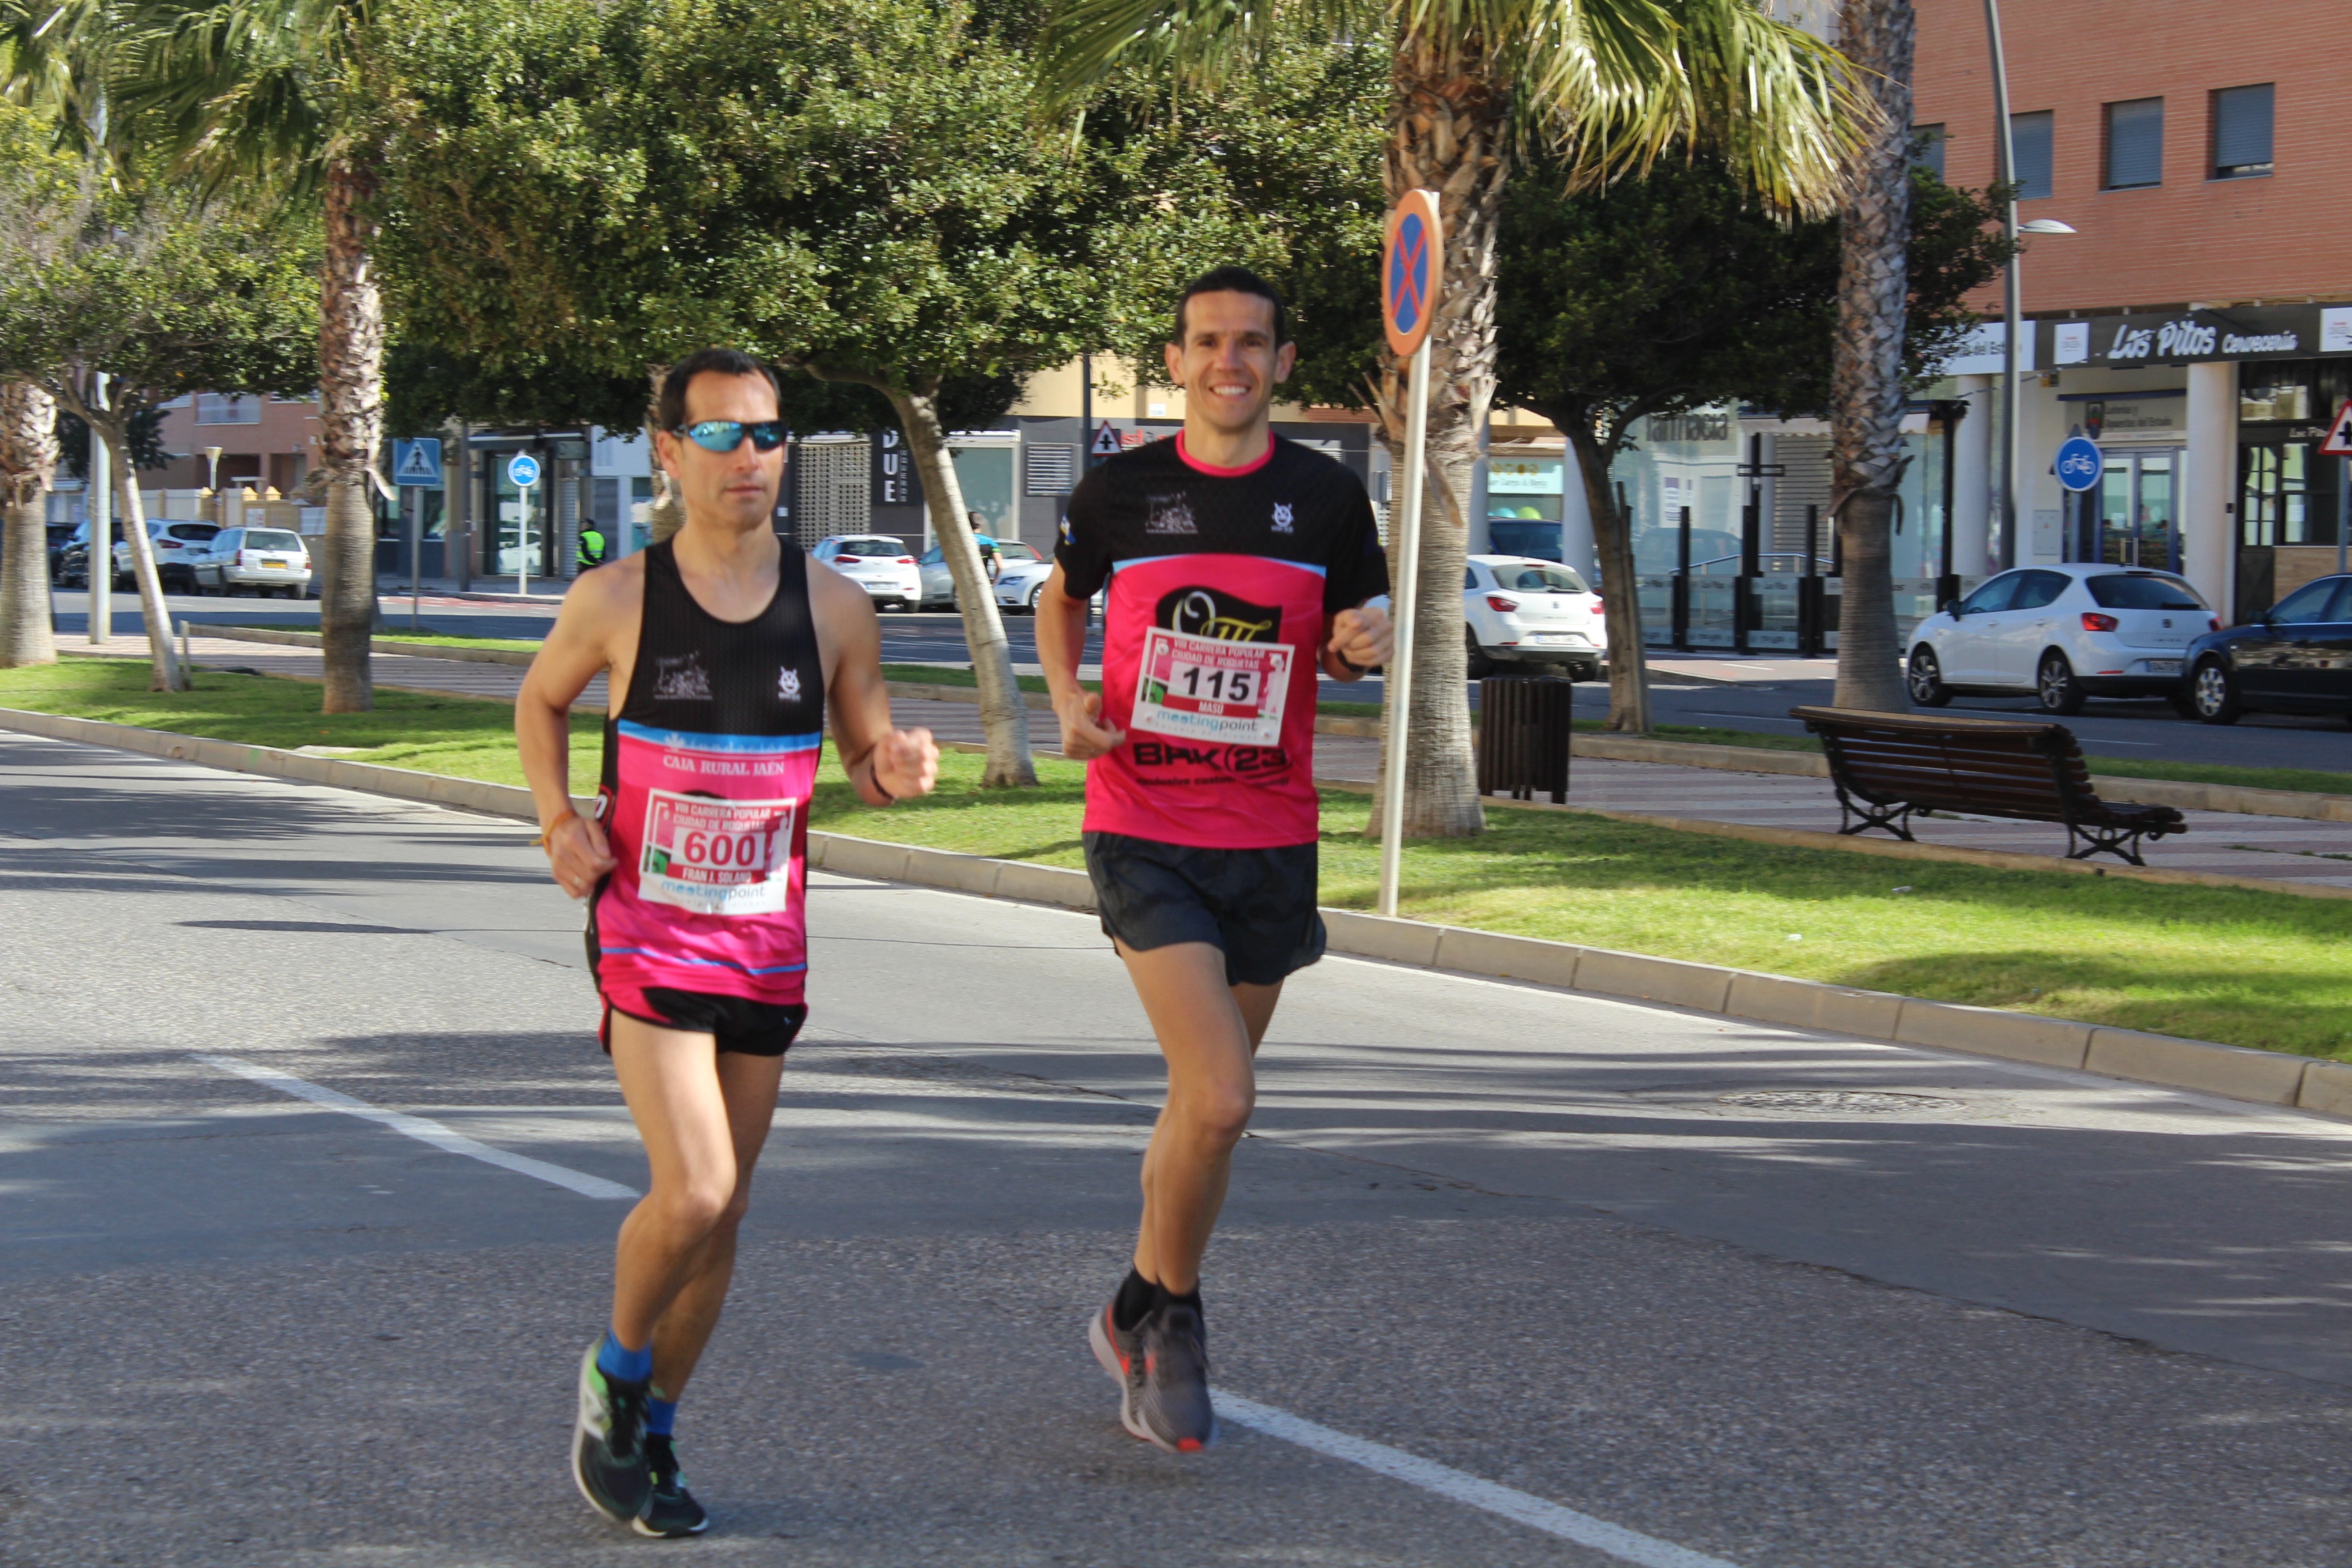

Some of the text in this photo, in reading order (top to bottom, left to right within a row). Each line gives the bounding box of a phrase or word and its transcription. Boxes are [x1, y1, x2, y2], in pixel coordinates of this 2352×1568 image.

[2108, 324, 2152, 359] Los
[2157, 320, 2217, 357] Pitos
[1188, 640, 1226, 655] CARRERA
[1228, 647, 1266, 659] POPULAR
[1171, 649, 1260, 670] CIUDAD DE ROQUETAS
[1183, 666, 1251, 702] 115
[700, 760, 750, 776] RURAL
[691, 803, 732, 818] CARRERA
[734, 806, 771, 819] POPULAR
[672, 813, 706, 828] CIUDAD
[708, 819, 719, 829] DE
[684, 831, 755, 866] 600
[682, 867, 707, 882] FRAN
